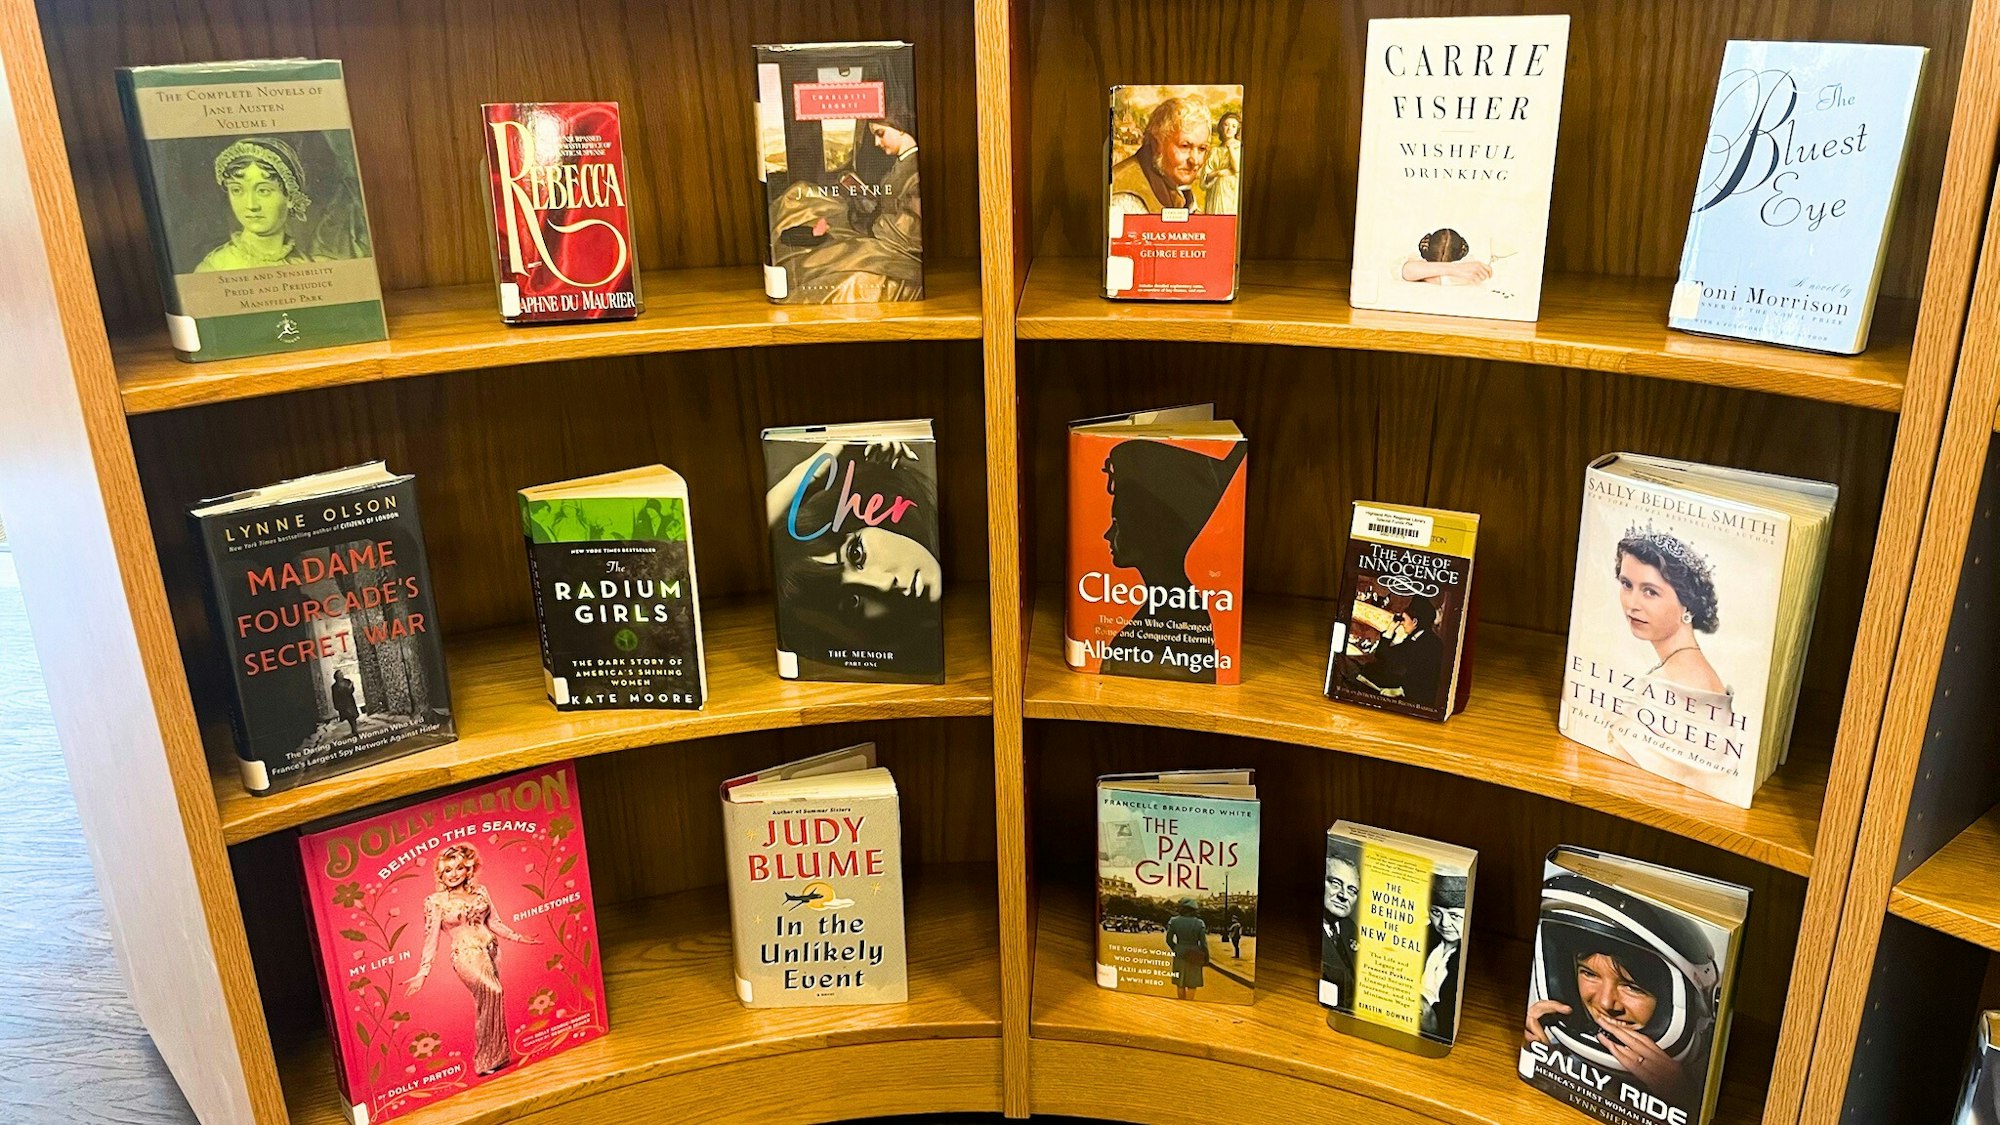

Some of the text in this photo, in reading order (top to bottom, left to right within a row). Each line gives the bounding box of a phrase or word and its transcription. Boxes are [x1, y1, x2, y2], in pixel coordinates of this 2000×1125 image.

[1385, 44, 1550, 77] CARRIE
[157, 86, 324, 102] THE COMPLETE NOVELS OF
[1816, 82, 1856, 111] The
[202, 103, 284, 117] JANE AUSTEN
[1393, 96, 1529, 120] FISHER
[216, 118, 276, 130] VOLUME I
[1400, 143, 1515, 160] WISHFUL
[1692, 68, 1868, 213] Bluest
[1404, 167, 1508, 182] DRINKING
[796, 184, 894, 200] JANE EYRE
[1760, 171, 1846, 232] Eye
[489, 121, 626, 288] REBECCA
[1142, 232, 1206, 240] SILAS MARNER
[1140, 250, 1207, 258] GEORGE ELIOT
[218, 267, 334, 284] SENSE AND SENSIBILITY
[224, 288, 255, 297] PRIDE
[282, 280, 334, 292] PREJUDICE
[240, 294, 324, 308] MANSFIELD PARK
[520, 290, 636, 314] APHNE DU MAURIER
[1746, 287, 1848, 316] Morrison
[787, 452, 918, 542] Cher
[1588, 477, 1637, 500] SALLY
[1642, 492, 1708, 520] BEDELL
[1712, 510, 1776, 537] SMITH
[225, 495, 397, 542] LYNNE OLSON
[247, 540, 397, 596] MADAME
[606, 560, 626, 574] The
[1370, 543, 1452, 570] THE AGE OF
[1358, 554, 1460, 585] INNOCENCE
[554, 579, 682, 600] RADIUM
[1078, 570, 1234, 616] Cleopatra
[237, 576, 420, 639] FOURCADE'S
[574, 604, 668, 624] GIRLS
[1095, 626, 1216, 646] Rome and Conquered Eternity
[1099, 615, 1213, 634] The Queen Who Challenged
[244, 612, 426, 676] SECRET WAR
[828, 650, 894, 660] THE MEMOIR
[572, 658, 683, 668] THE DARK STORY OF
[1083, 639, 1232, 674] Alberto Angela
[576, 668, 682, 678] AMERICA'S SHINING
[610, 678, 652, 687] WOMEN
[571, 693, 694, 705] KATE MOORE
[1572, 656, 1748, 732] ELIZABETH
[1570, 680, 1744, 760] THE QUEEN
[271, 723, 441, 776] France's Largest Spy Network Against Hitler
[285, 716, 425, 760] The Daring Young Woman Who Led
[1572, 706, 1590, 720] The
[1593, 715, 1614, 730] Life
[1618, 725, 1630, 736] of
[1642, 735, 1683, 756] Modern
[1688, 752, 1740, 778] Monarch
[1104, 798, 1252, 818] FRANCELLE BRADFORD WHITE
[324, 768, 571, 881] DOLLY PARTON
[762, 816, 865, 848] JUDY
[1142, 816, 1178, 836] THE
[377, 820, 537, 880] BEHIND THE SEAMS
[1158, 836, 1238, 868] PARIS
[748, 849, 886, 882] BLUME
[1135, 859, 1209, 891] GIRL
[1386, 882, 1402, 894] THE
[513, 891, 581, 923] RHINESTONES
[1372, 890, 1415, 911] WOMAN
[776, 914, 866, 936] In the
[1371, 904, 1414, 925] BEHIND
[1384, 921, 1399, 932] THE
[1122, 946, 1148, 954] YOUNG
[1149, 949, 1176, 957] WOMAN
[1361, 926, 1421, 953] NEW DEAL
[349, 950, 412, 978] MY LIFE IN
[761, 940, 884, 966] Unlikely
[1132, 957, 1171, 966] OUTWITTED
[784, 970, 866, 991] Event
[1153, 969, 1180, 978] BECAME
[1386, 1010, 1413, 1023] DOWNEY
[388, 1064, 462, 1098] DOLLY PARTON
[1530, 1040, 1688, 1125] SALLY RIDE
[1534, 1065, 1640, 1120] MERICA'S FIRST WOMAN
[1568, 1093, 1597, 1114] LYNN
